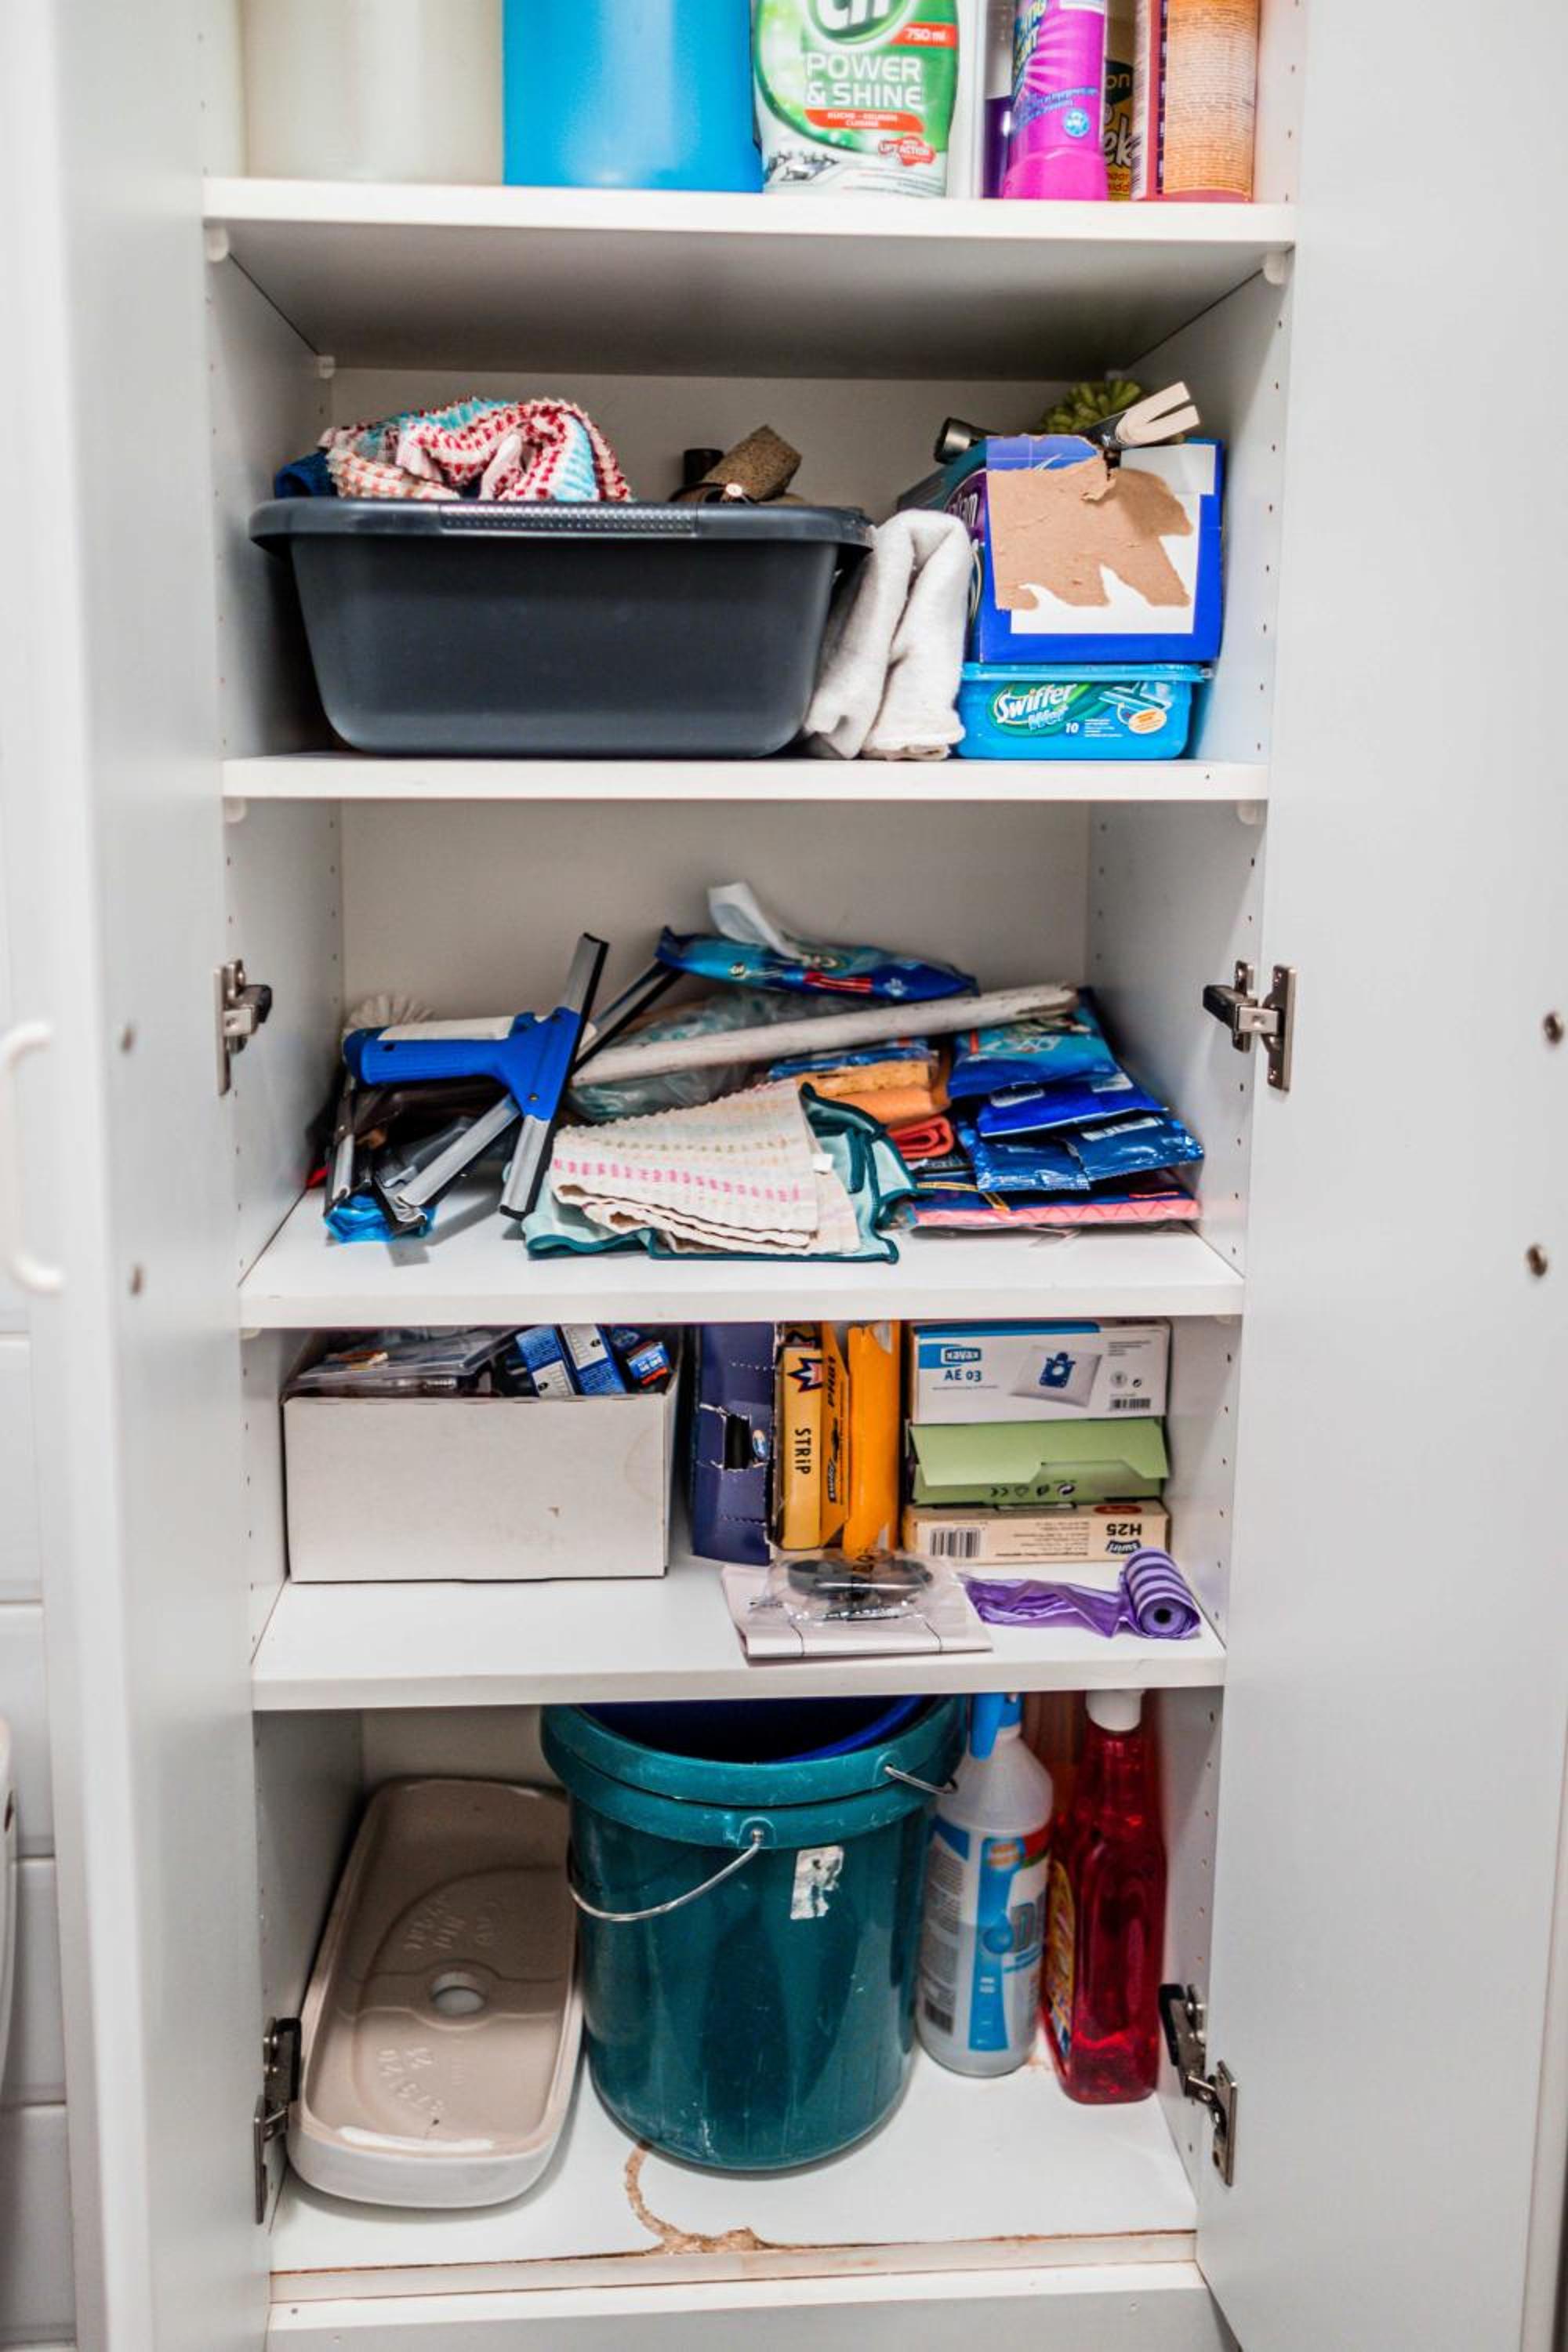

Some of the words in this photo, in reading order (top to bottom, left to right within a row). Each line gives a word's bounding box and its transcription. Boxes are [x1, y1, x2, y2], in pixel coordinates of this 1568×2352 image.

[906, 27, 930, 38] 750
[807, 52, 922, 83] POWER
[807, 81, 826, 105] &
[832, 82, 927, 112] SHINE
[899, 144, 930, 156] ACTION
[995, 684, 1077, 724] Swiffer
[1065, 722, 1079, 734] 10
[946, 1350, 980, 1361] xavax
[944, 1369, 962, 1381] AE
[966, 1370, 982, 1382] 03
[1106, 1523, 1142, 1537] H25
